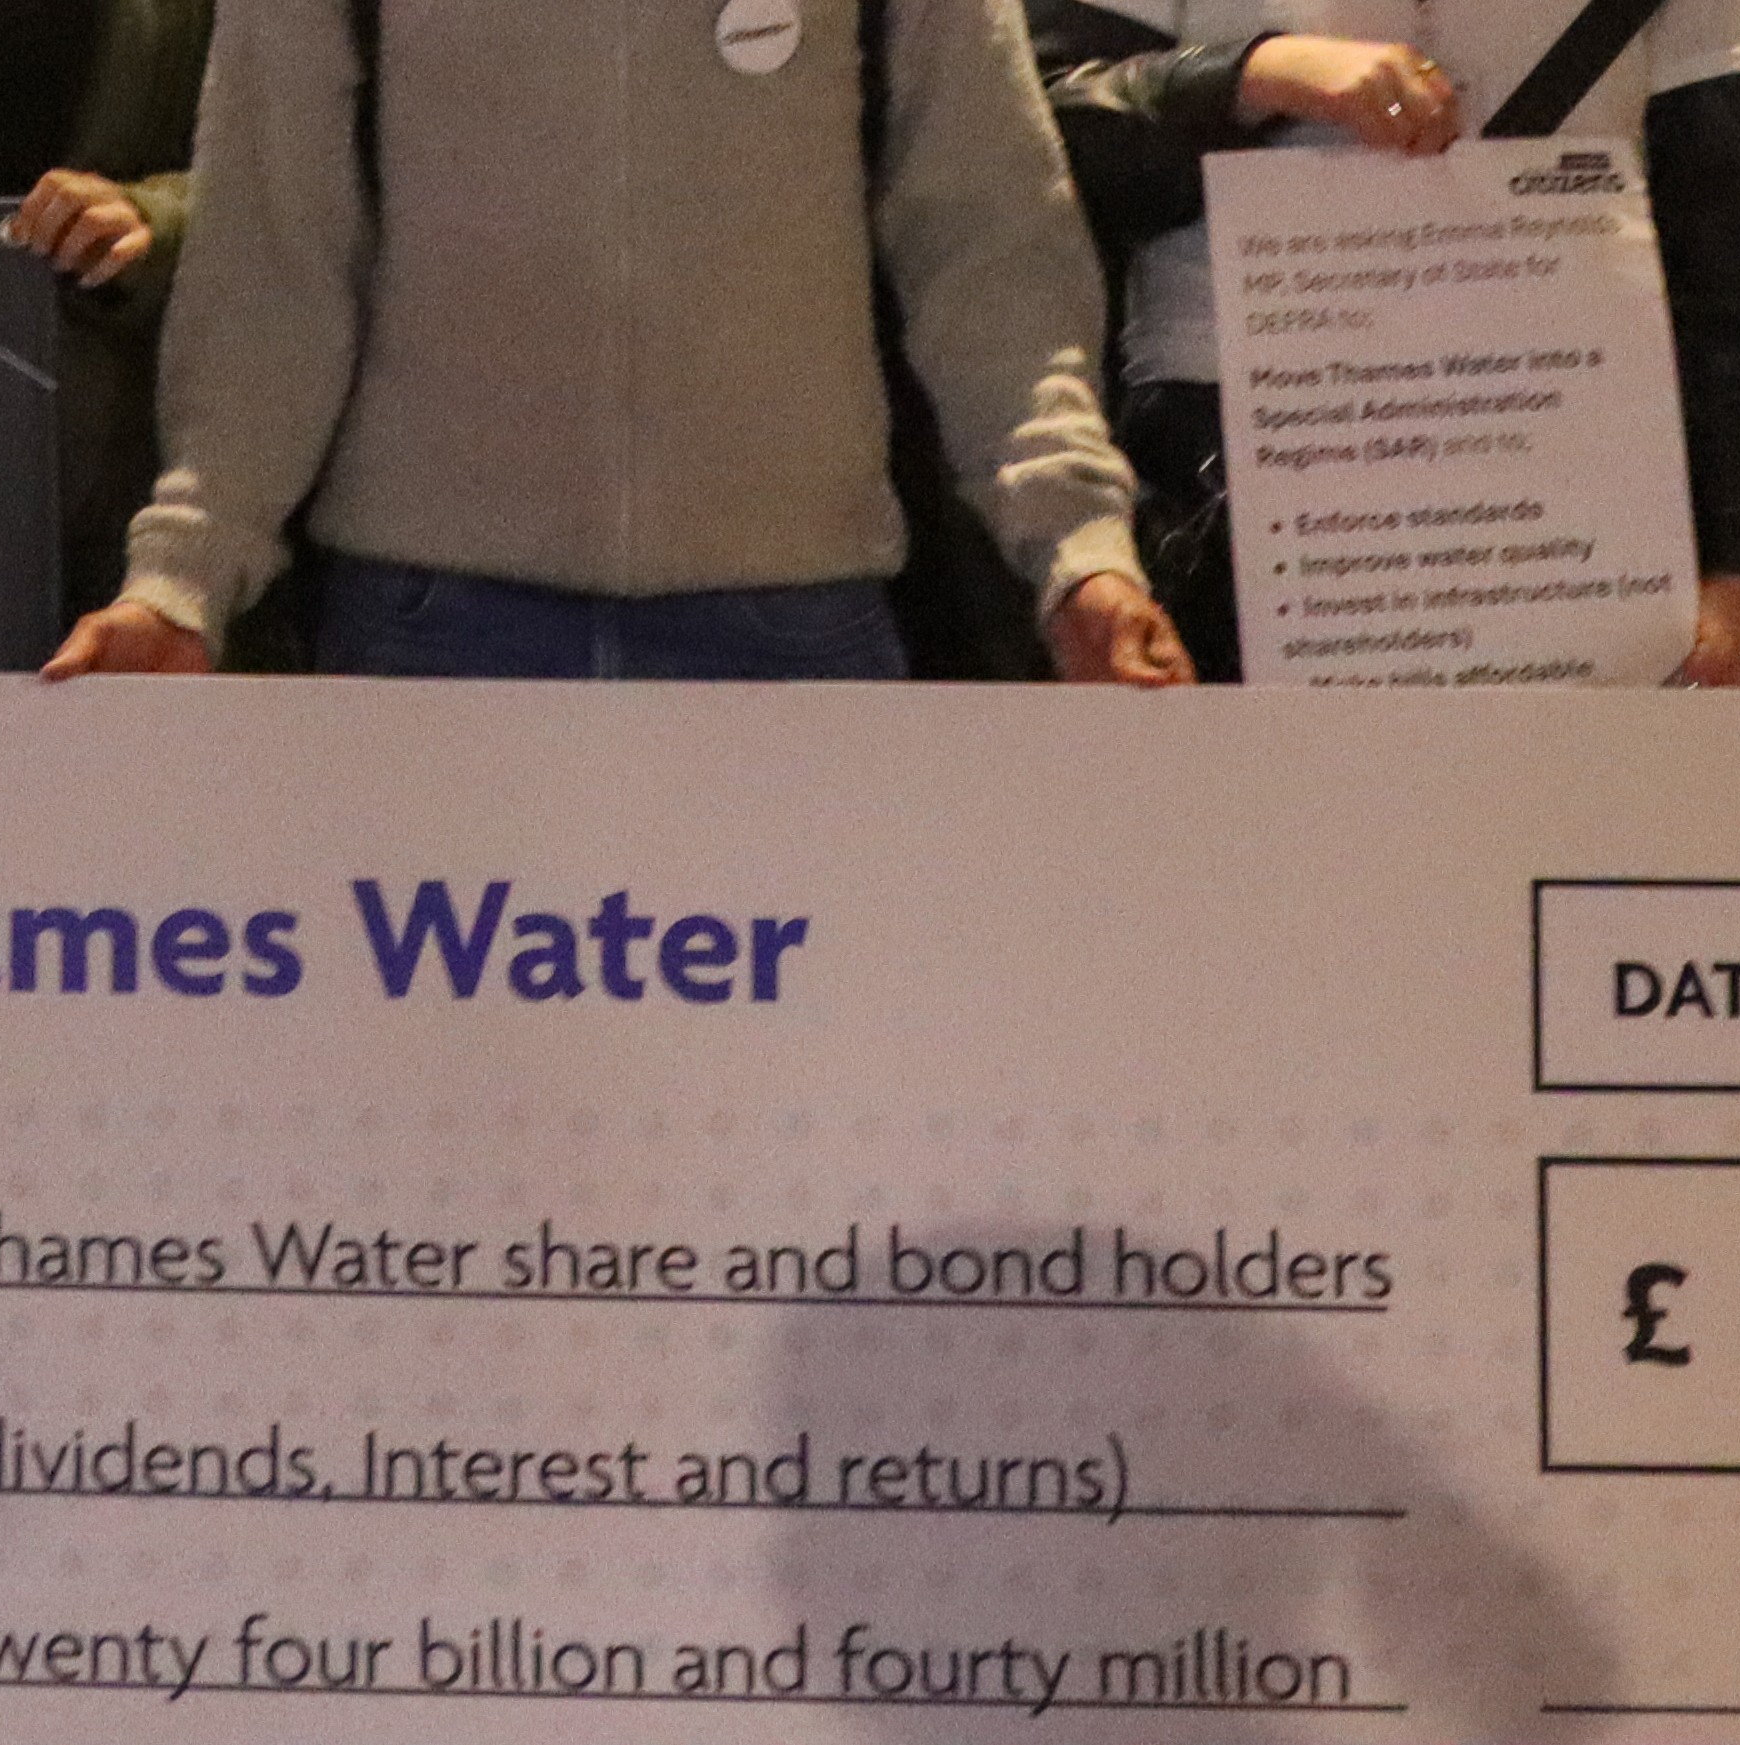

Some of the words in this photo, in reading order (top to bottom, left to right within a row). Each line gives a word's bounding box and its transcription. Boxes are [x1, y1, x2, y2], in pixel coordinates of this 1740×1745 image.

[1421, 222, 1504, 245] Emma
[1422, 263, 1447, 283] of
[1452, 259, 1520, 281] State
[1526, 255, 1559, 275] for
[1250, 368, 1321, 389] Move
[1325, 360, 1434, 383] Thames
[1440, 353, 1520, 377] Water
[1526, 350, 1581, 369] into
[1586, 350, 1602, 367] a
[1252, 403, 1354, 429] Special
[1360, 391, 1561, 419] Administration
[1256, 444, 1356, 470] Regime
[1363, 435, 1437, 460] (SAR)
[1443, 434, 1491, 455] and
[1295, 512, 1401, 536] Enforce
[1406, 500, 1543, 526] standards
[1299, 553, 1410, 577] Improve
[1419, 547, 1496, 568] water
[1499, 537, 1595, 563] quality
[1302, 593, 1386, 618] Invest
[1391, 593, 1419, 611] in
[1422, 578, 1612, 609] infrastructure
[1617, 573, 1672, 597] (not
[1284, 625, 1472, 658] shareholders)
[1454, 659, 1595, 685] affordable
[351, 879, 809, 1002] Water
[251, 1219, 476, 1290] Water
[503, 1221, 698, 1295] share
[725, 1225, 860, 1297] and
[887, 1225, 1084, 1299] bond
[1118, 1226, 1393, 1301] holders
[1622, 1263, 1691, 1367] £
[364, 1430, 645, 1503] Interest
[676, 1434, 811, 1505] and
[840, 1432, 1129, 1526] returns)
[233, 1613, 390, 1691] four
[419, 1617, 643, 1697] billion
[672, 1623, 809, 1696] and
[839, 1623, 1068, 1717] fourty
[1100, 1625, 1350, 1703] million
